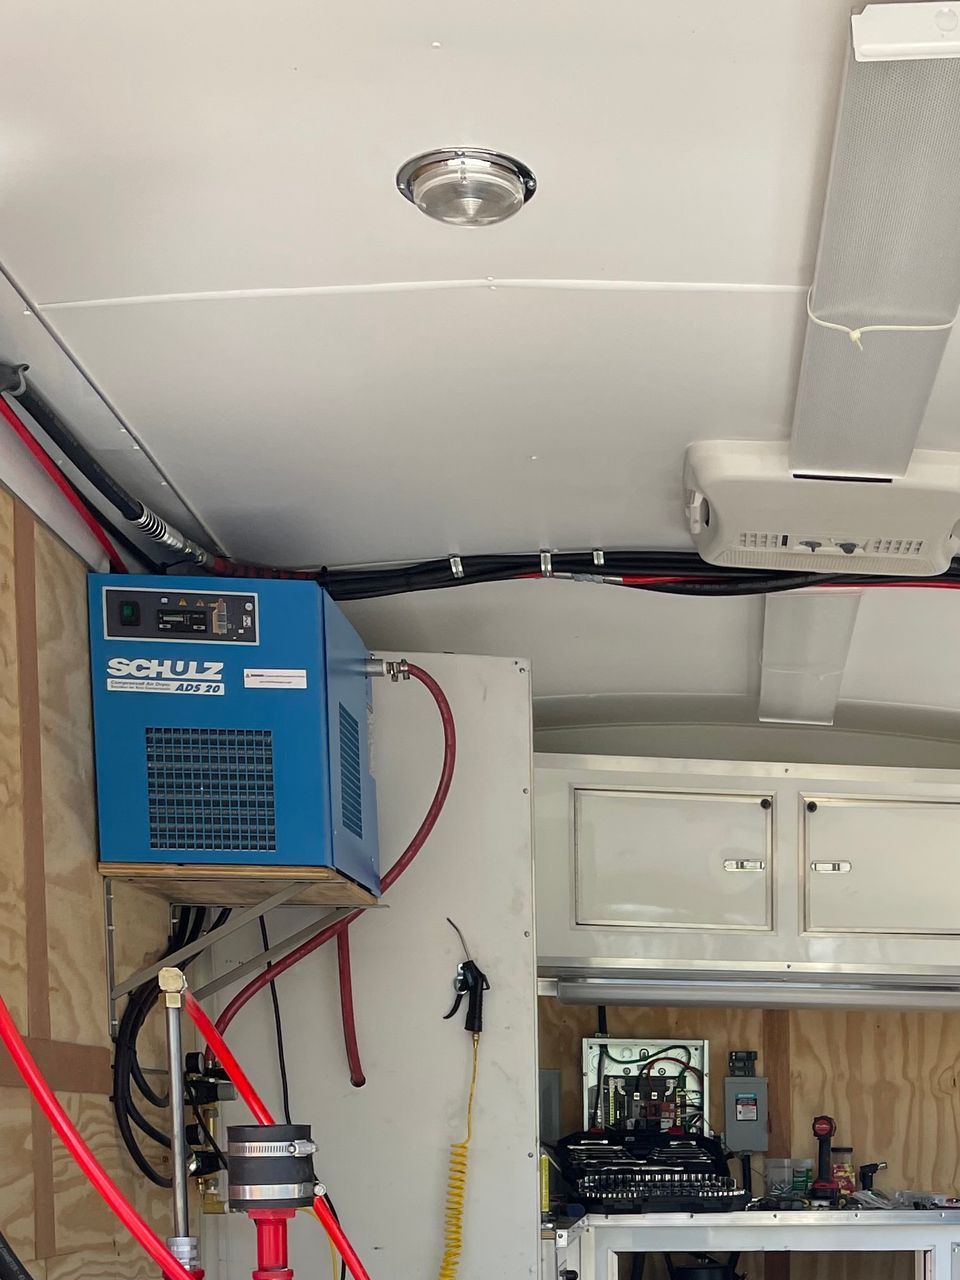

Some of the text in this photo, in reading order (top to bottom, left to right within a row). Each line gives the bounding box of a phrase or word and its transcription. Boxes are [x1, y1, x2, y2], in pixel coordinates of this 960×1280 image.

[106, 658, 224, 680] SCHULZ
[175, 683, 201, 692] ADS
[204, 684, 221, 693] 20
